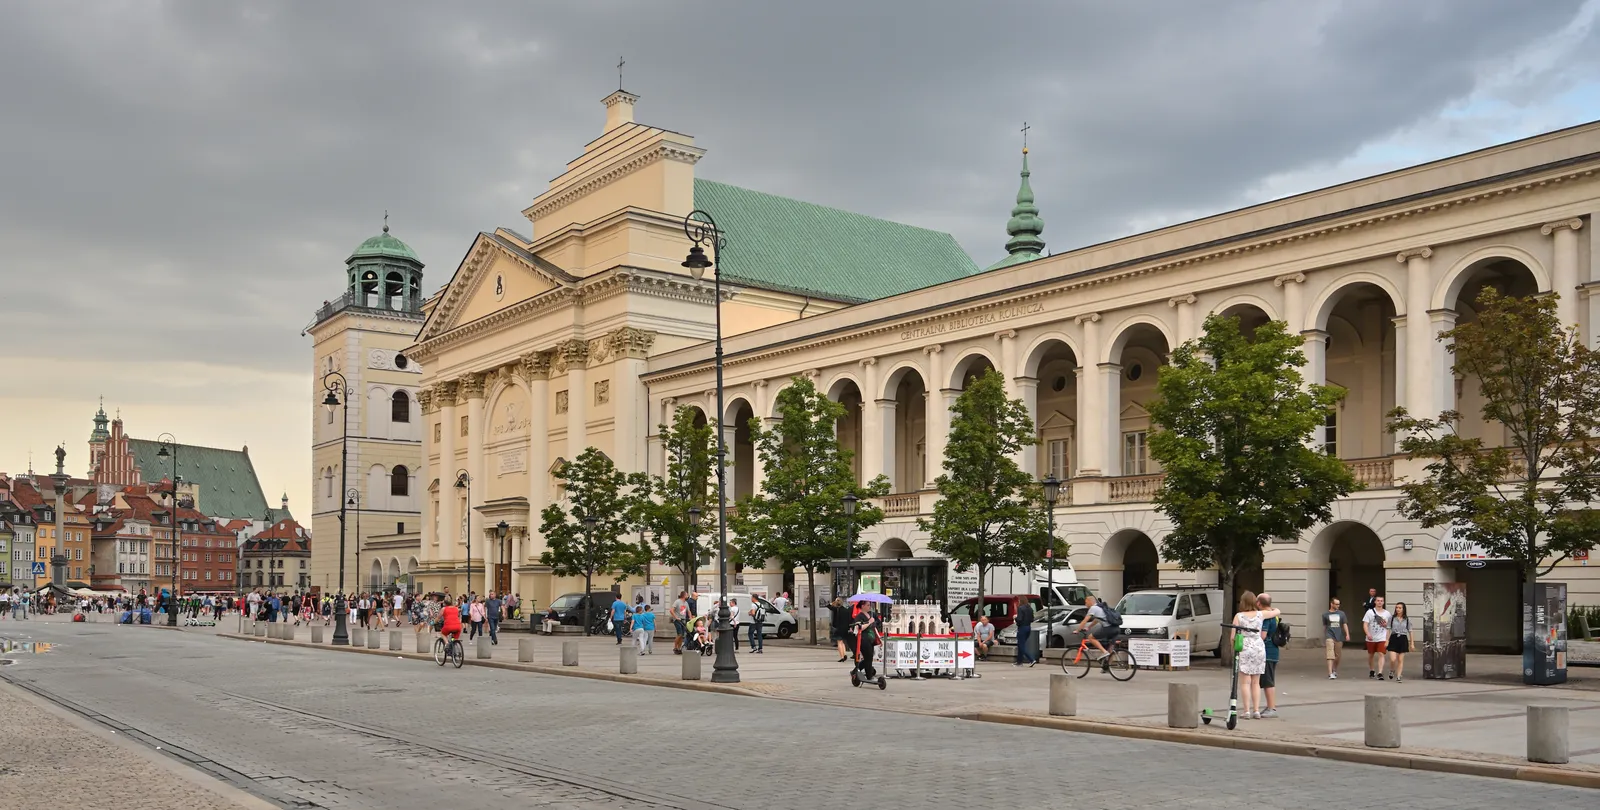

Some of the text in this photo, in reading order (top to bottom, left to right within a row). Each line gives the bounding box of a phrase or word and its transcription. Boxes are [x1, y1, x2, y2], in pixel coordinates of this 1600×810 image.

[900, 303, 1045, 341] CENTRALNA BIBLIOTEKA ROLNICZA
[1443, 541, 1474, 552] WARSAW
[904, 642, 913, 650] OLD
[938, 642, 949, 650] PARK
[933, 650, 954, 659] MINIATUR
